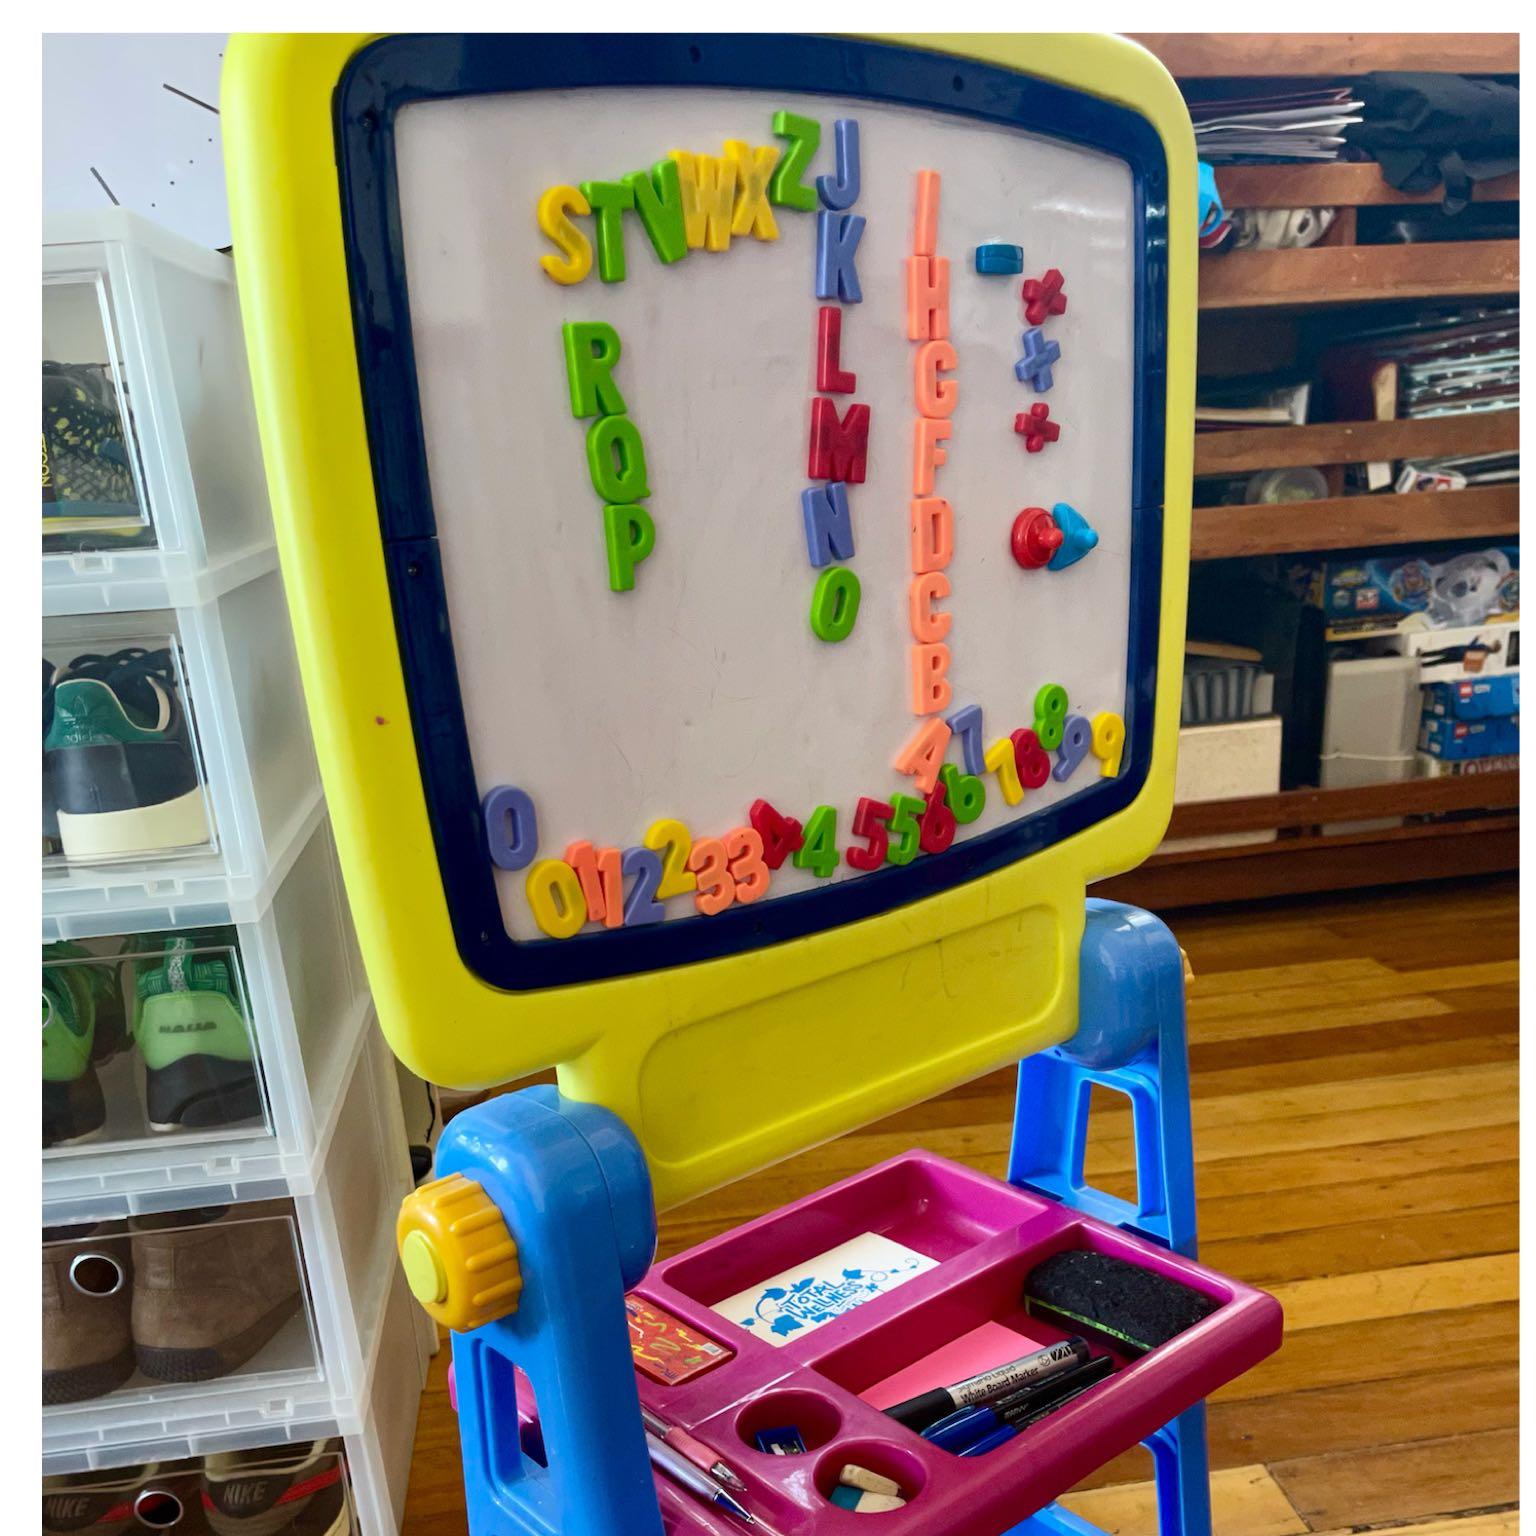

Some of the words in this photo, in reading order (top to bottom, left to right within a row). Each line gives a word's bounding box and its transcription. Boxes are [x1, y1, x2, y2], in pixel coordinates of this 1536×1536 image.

[960, 1388, 986, 1404] White
[986, 1377, 1011, 1393] Board
[1010, 1367, 1039, 1383] Marker
[223, 1481, 267, 1503] NIKE
